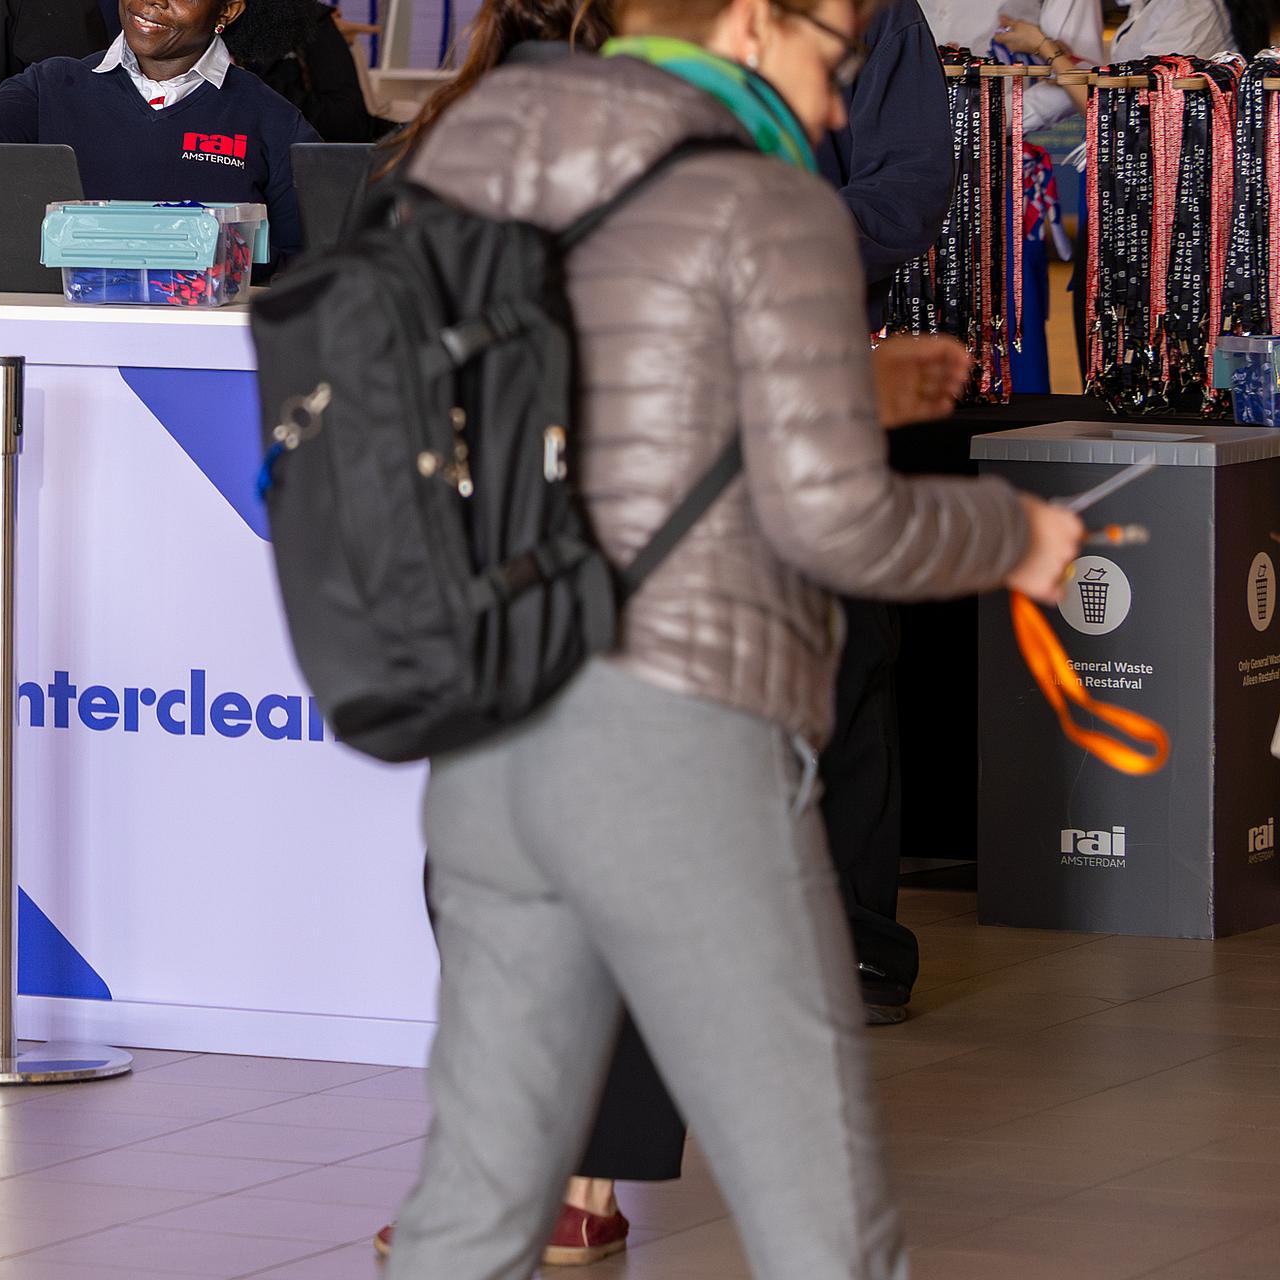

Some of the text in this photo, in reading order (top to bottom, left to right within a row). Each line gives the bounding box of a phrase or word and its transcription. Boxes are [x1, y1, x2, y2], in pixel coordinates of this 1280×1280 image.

[182, 131, 247, 158] rai
[954, 112, 964, 160] NEXARO
[1101, 115, 1109, 162] NEXARO
[1117, 131, 1125, 179] NEXARO
[181, 151, 245, 169] AMSTERDAM
[1117, 208, 1125, 255] NEXARO
[1130, 213, 1138, 261] NEXARO
[948, 237, 957, 285] NEXARO
[1173, 232, 1186, 280] NEXARO
[1182, 240, 1193, 288] NEXARO
[1193, 274, 1201, 322] NEXARO
[1066, 659, 1153, 675] General Waste
[1085, 676, 1142, 690] Restafval
[17, 669, 348, 743] nterclea
[1061, 825, 1126, 856] rai
[1248, 817, 1274, 853] rai
[1060, 855, 1126, 868] AMSTERDAM
